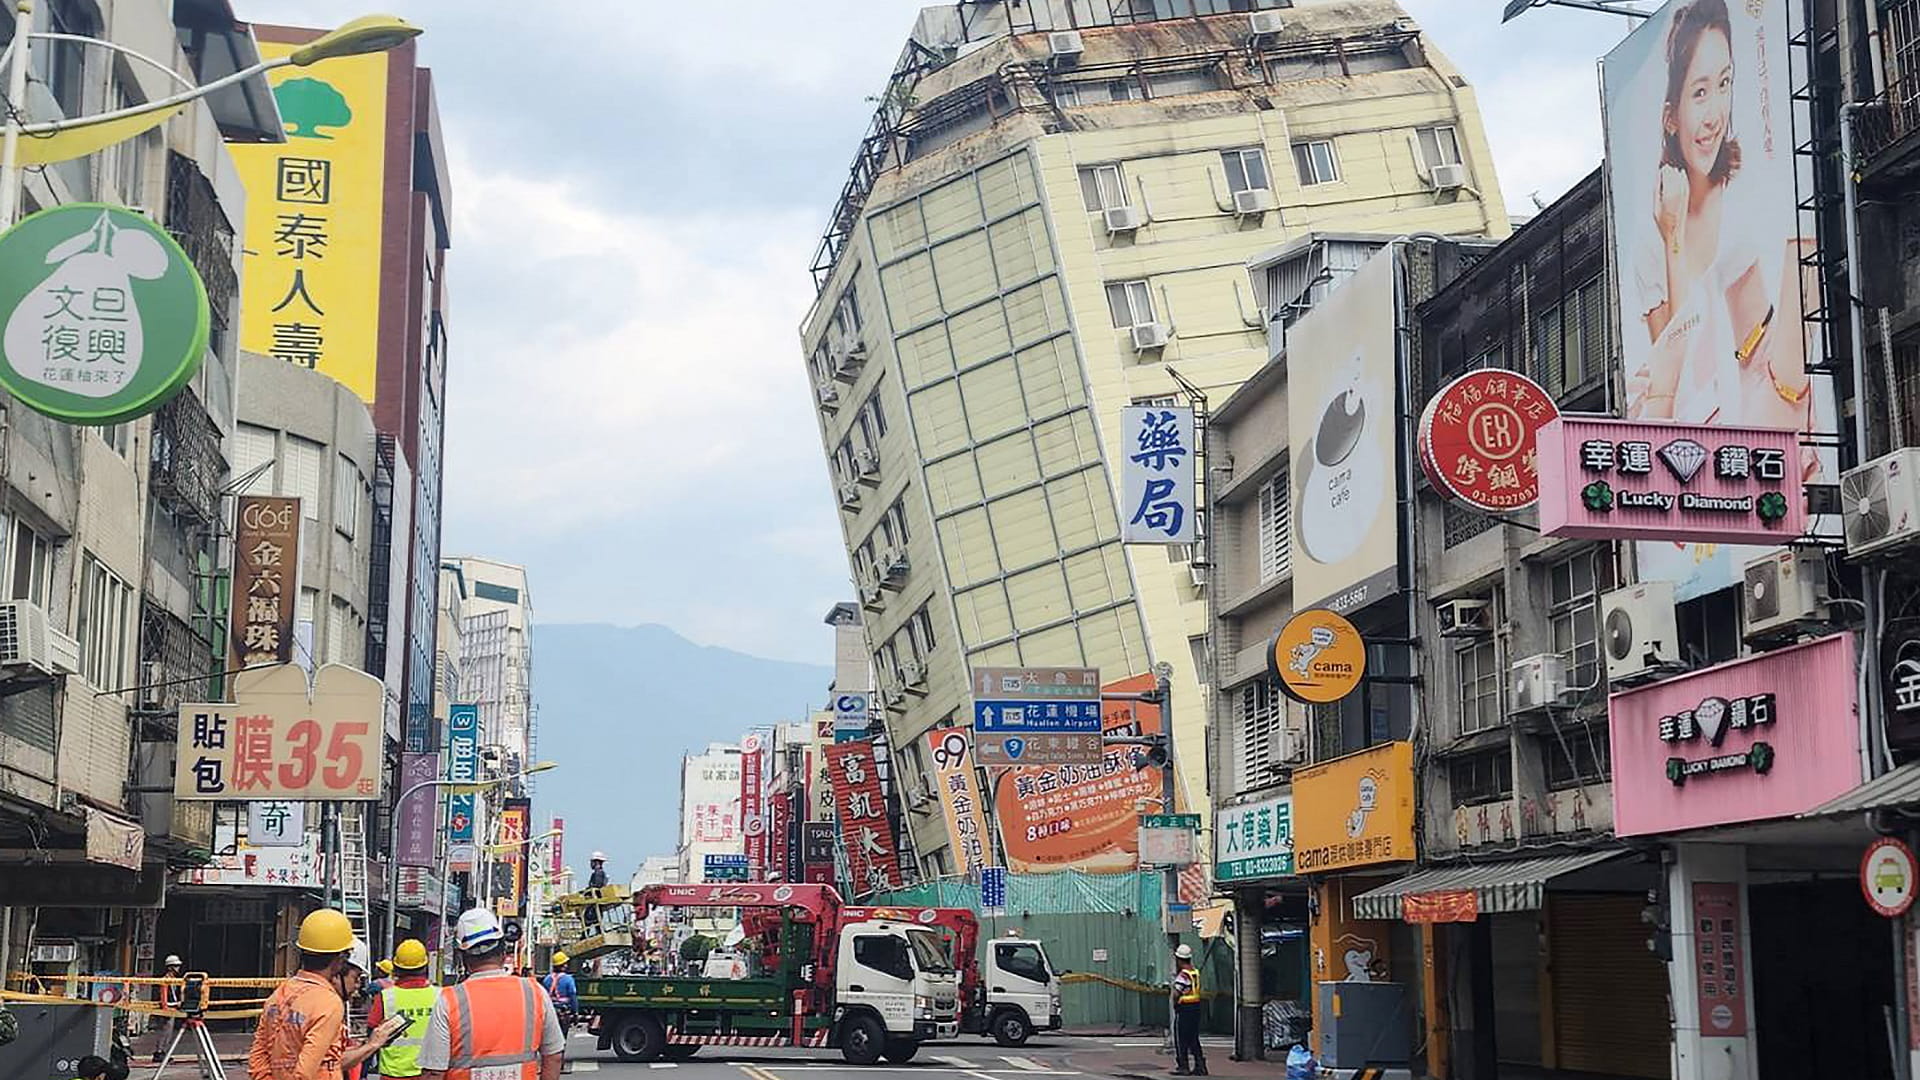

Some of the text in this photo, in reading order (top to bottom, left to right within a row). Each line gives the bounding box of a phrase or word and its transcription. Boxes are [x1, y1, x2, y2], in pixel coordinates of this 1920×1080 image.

[270, 157, 331, 369] 國泰人壽
[43, 285, 128, 322] 文旦
[41, 325, 126, 365] 復興
[42, 367, 125, 384] 花蓮柚來了
[1582, 440, 1785, 480] 幸運 鑽石
[1130, 411, 1187, 537] 藥局
[1620, 490, 1753, 512] Lucky Diamond
[1313, 661, 1353, 673] cama
[1026, 704, 1099, 718] 花蓮機場
[1026, 719, 1098, 728] Hualien Airport
[1659, 710, 1694, 740] 幸運
[934, 734, 967, 771] 99
[1009, 740, 1020, 752] 9
[1682, 754, 1746, 774] LUCKY DIAMOND
[1297, 846, 1330, 869] cama
[1231, 861, 1244, 877] TEL
[668, 887, 696, 897] UNIC
